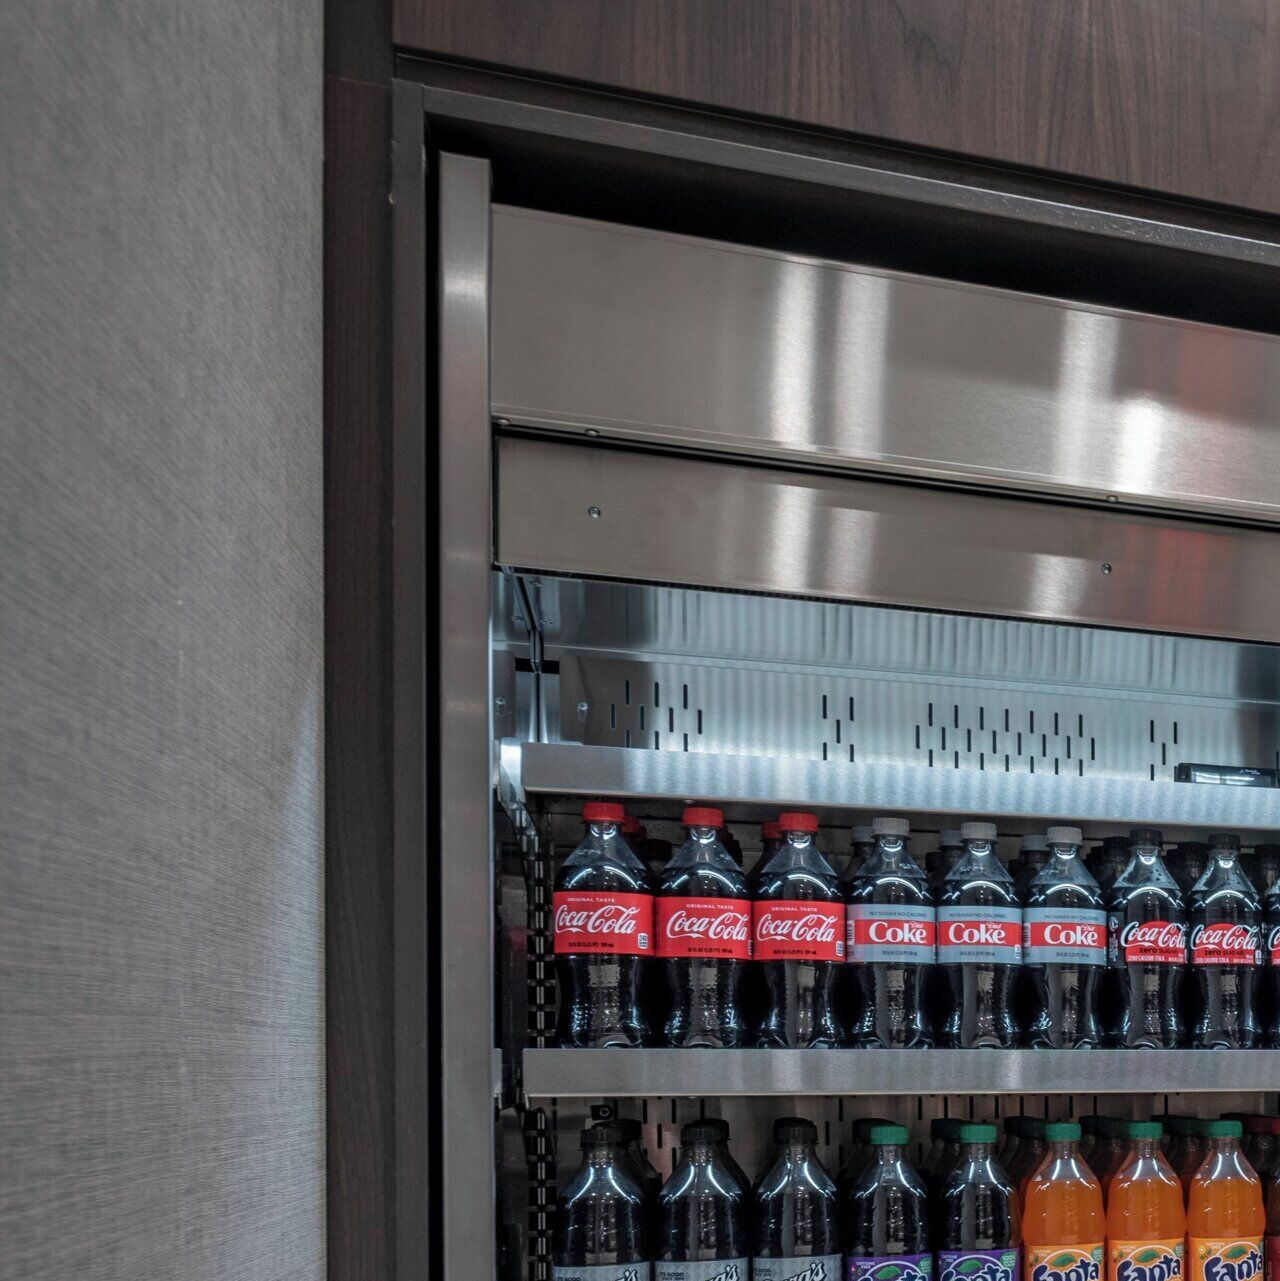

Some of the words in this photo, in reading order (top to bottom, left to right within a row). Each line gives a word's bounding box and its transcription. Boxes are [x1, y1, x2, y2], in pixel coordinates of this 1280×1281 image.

[555, 905, 640, 934] Coca-Cola
[666, 911, 749, 940] Coca-Cola
[757, 914, 838, 942] Coca-Cola
[869, 922, 926, 943] Coke
[949, 923, 1005, 944] Coke
[1044, 924, 1097, 945] Coke
[1121, 922, 1187, 950] Coca-Cola
[1191, 925, 1261, 950] Coca-Cola
